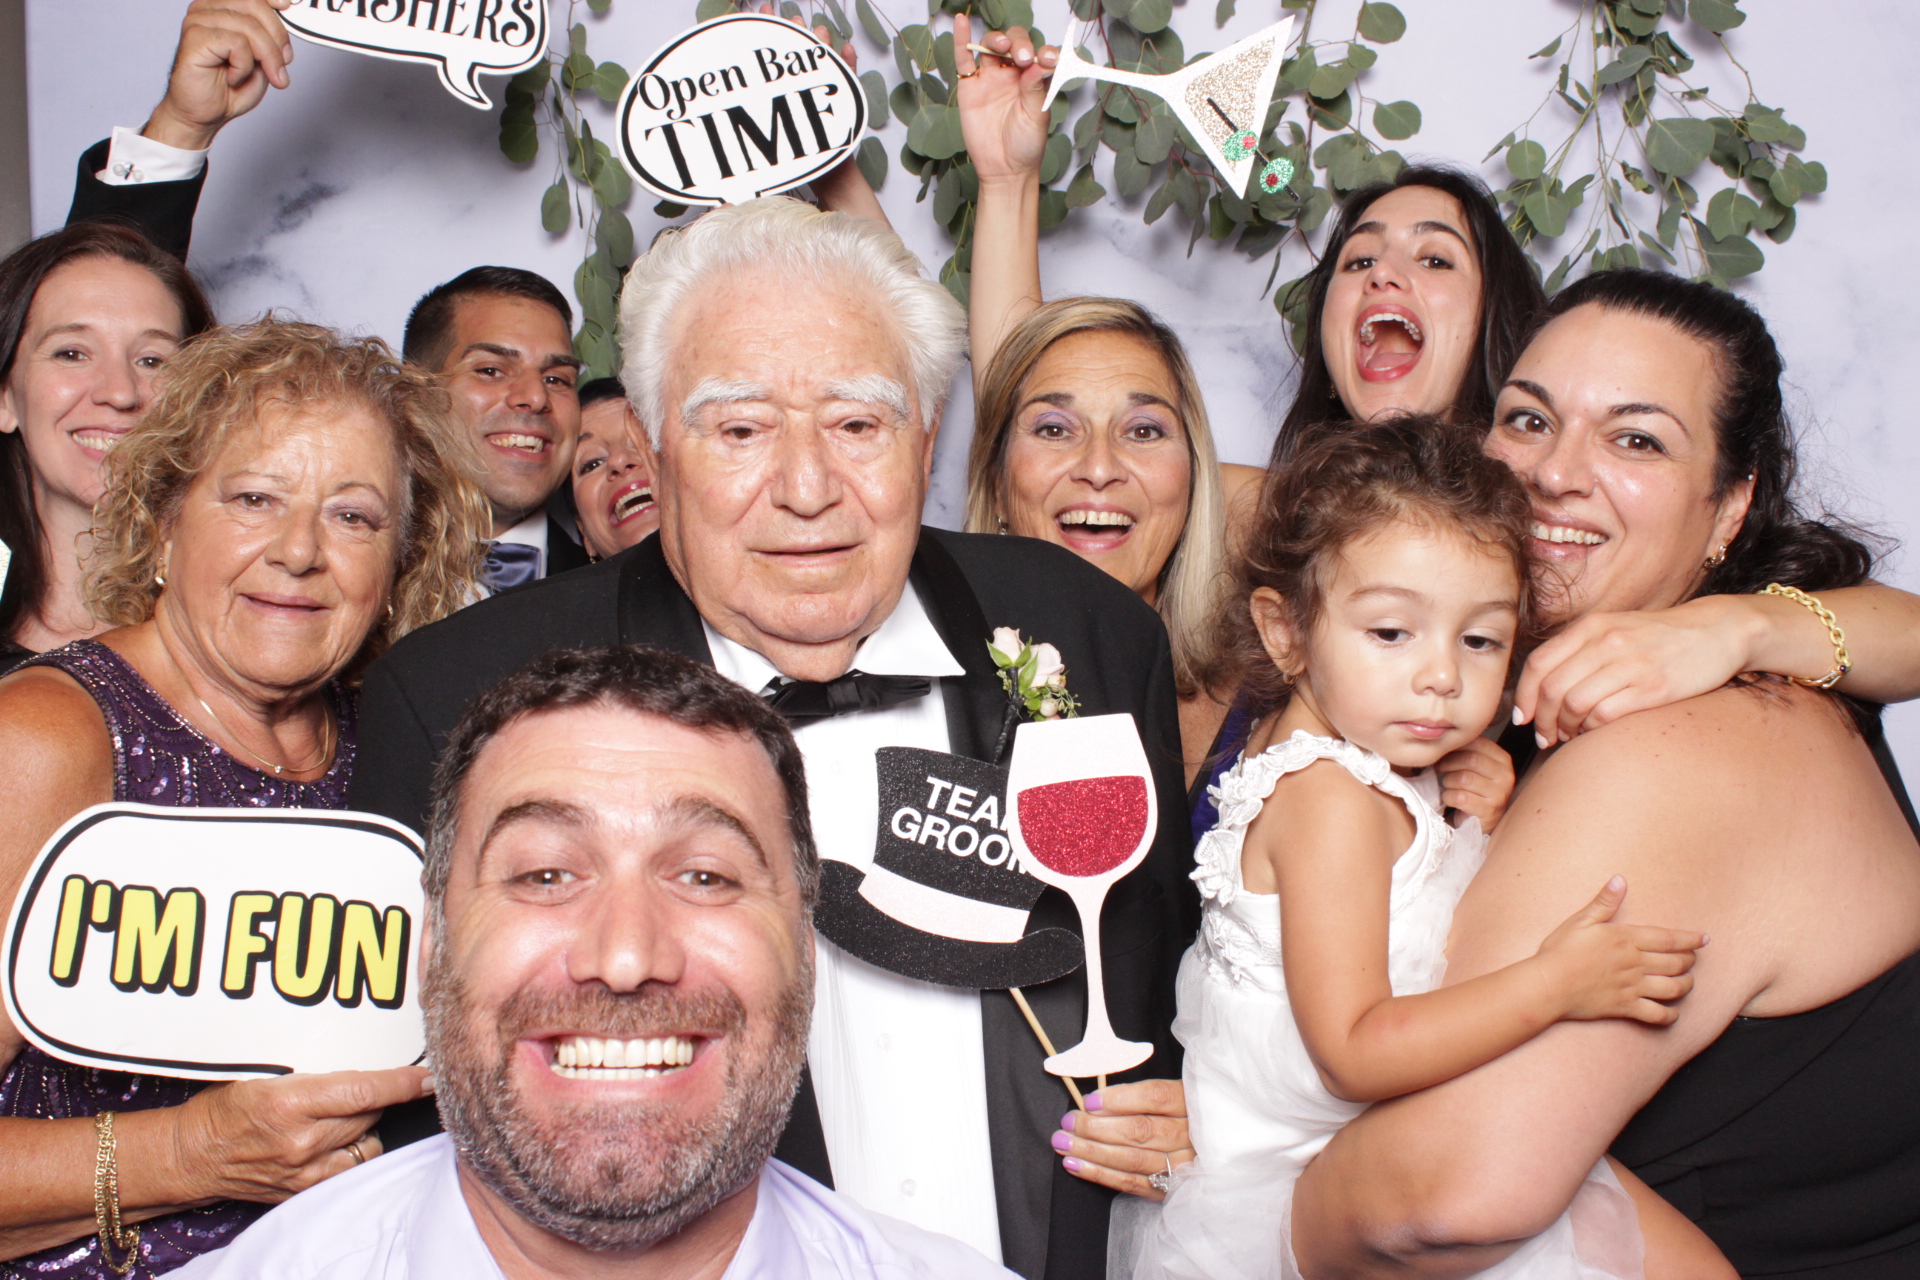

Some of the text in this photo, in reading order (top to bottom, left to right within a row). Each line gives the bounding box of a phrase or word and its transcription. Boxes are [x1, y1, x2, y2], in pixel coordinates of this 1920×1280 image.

[638, 45, 827, 121] Open Bar
[644, 84, 853, 190] TIME
[926, 775, 1008, 832] TEA
[49, 874, 411, 1010] I'M FUN
